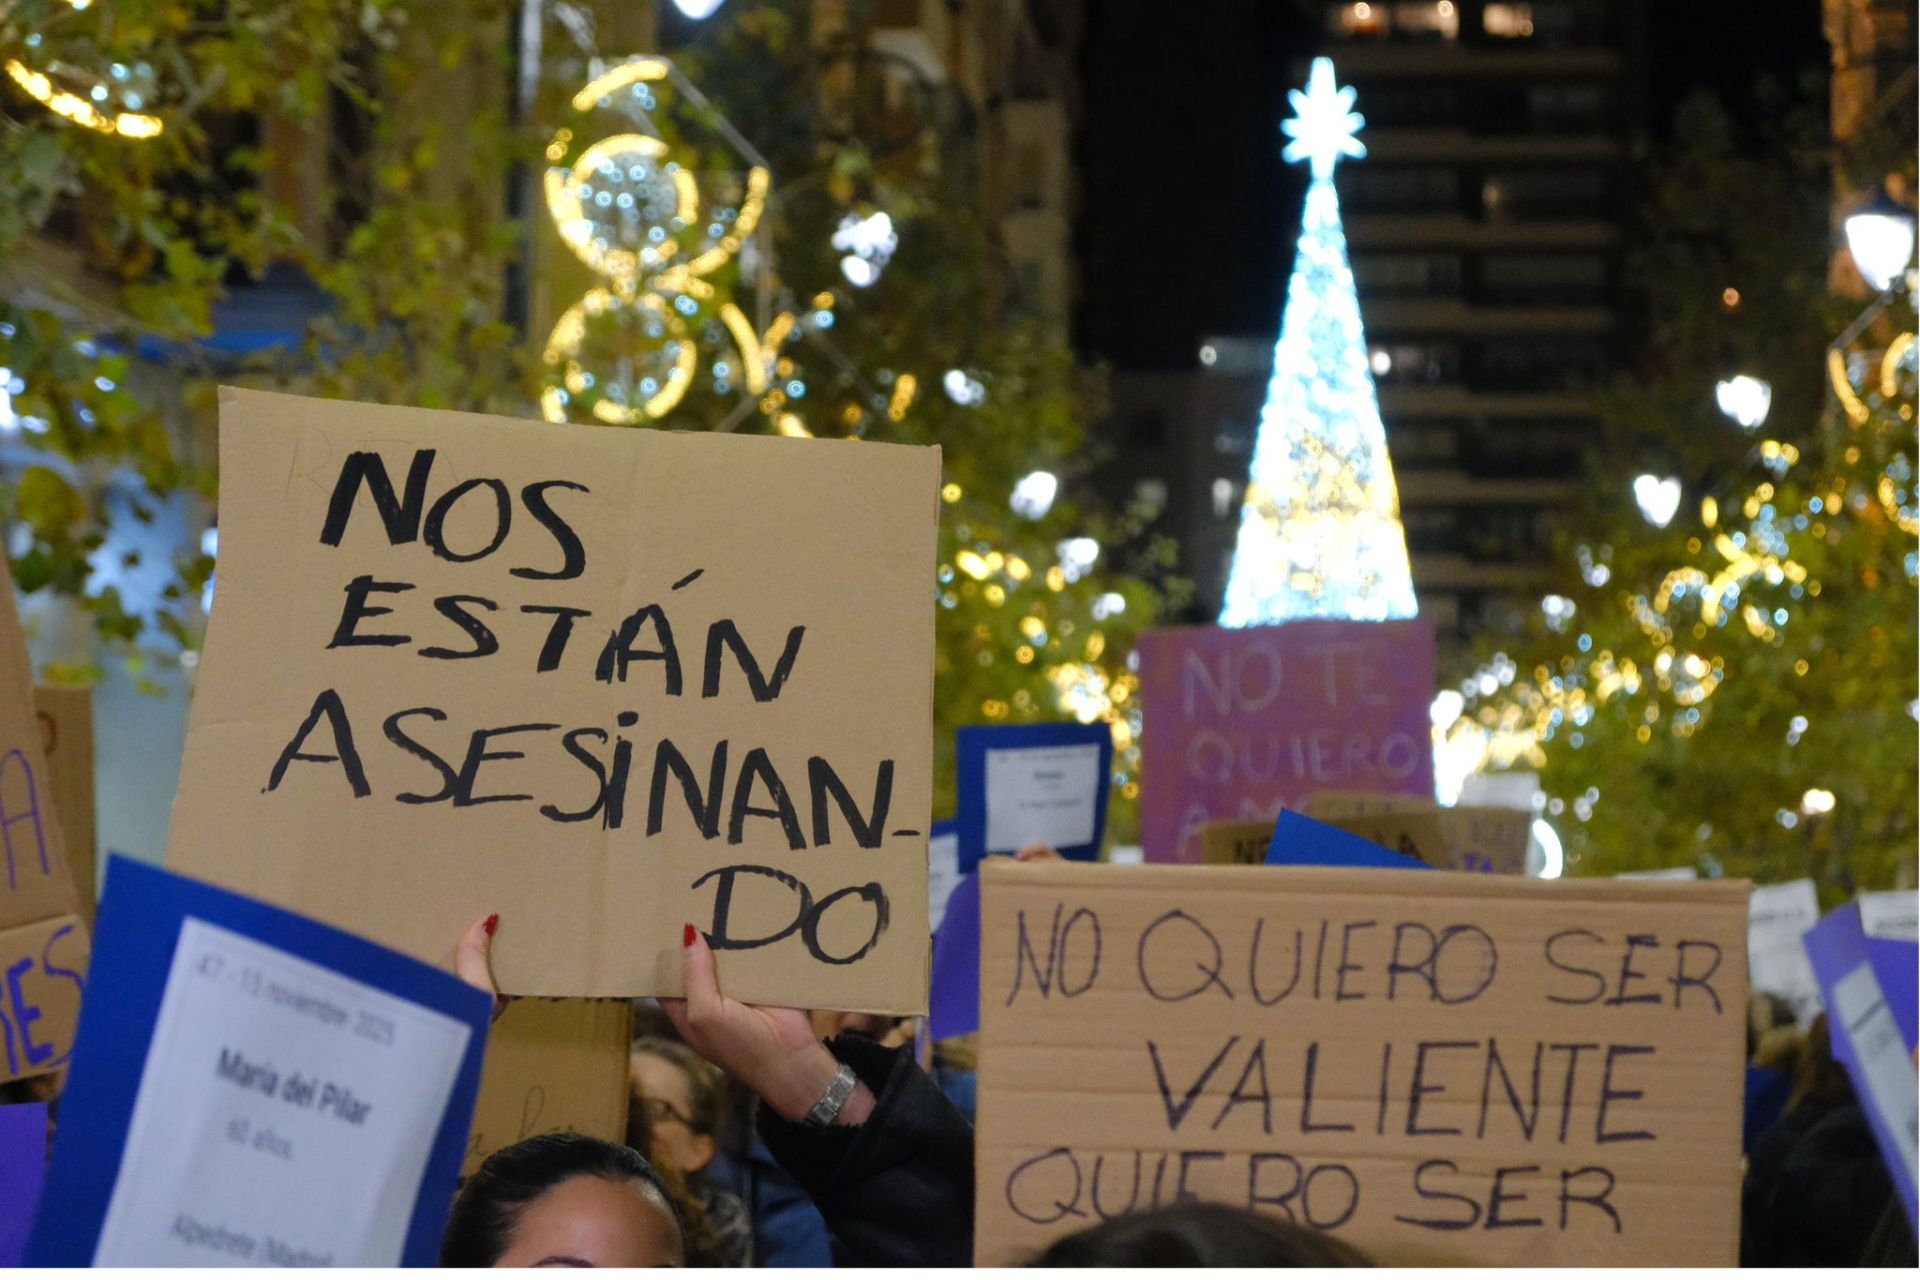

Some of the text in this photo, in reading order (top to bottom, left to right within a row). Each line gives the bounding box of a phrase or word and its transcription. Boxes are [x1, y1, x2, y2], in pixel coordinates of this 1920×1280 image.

[320, 448, 591, 580] NOS
[326, 568, 806, 702] ESTÁN
[1183, 640, 1390, 720] NO TE
[1186, 728, 1421, 784] QUIERO
[691, 864, 890, 965] DO
[1007, 903, 1723, 1014] NO QUIERO SER
[280, 1070, 319, 1108] del
[318, 1080, 372, 1127] Pilar
[1147, 1036, 1658, 1143] VALIENTE
[1395, 1158, 1624, 1234] SER
